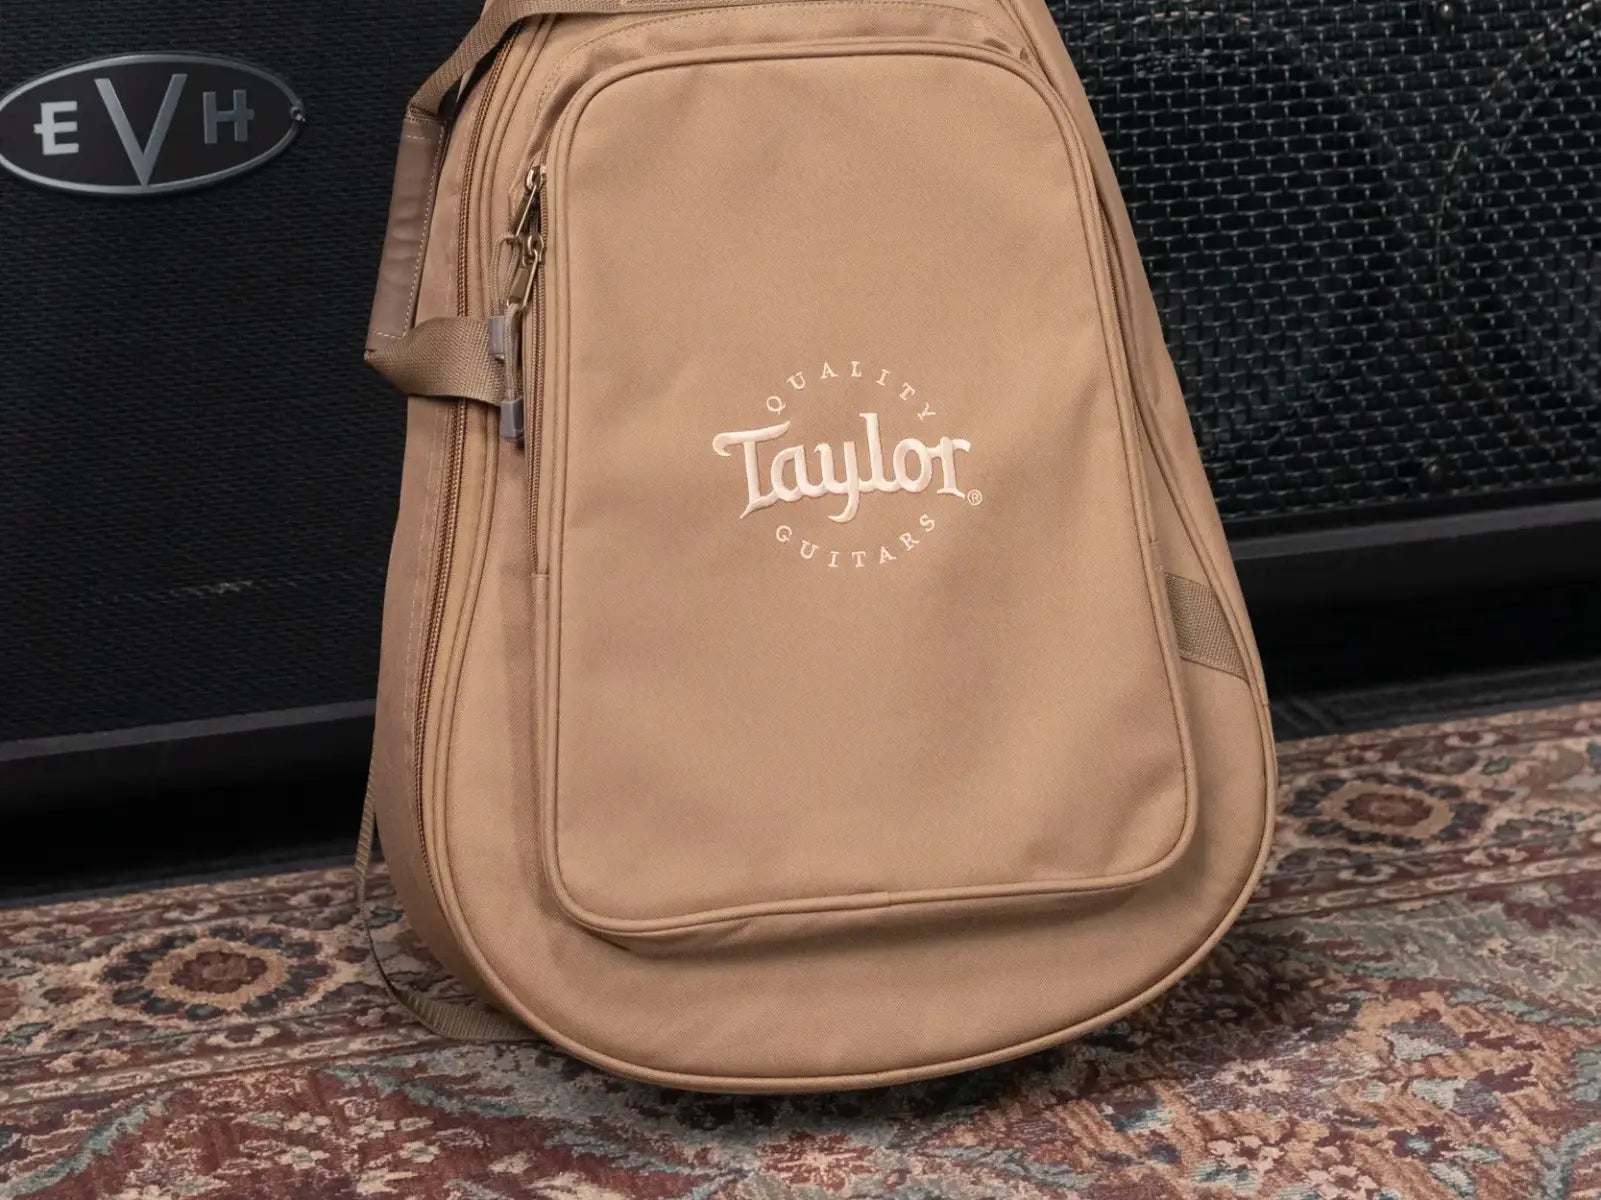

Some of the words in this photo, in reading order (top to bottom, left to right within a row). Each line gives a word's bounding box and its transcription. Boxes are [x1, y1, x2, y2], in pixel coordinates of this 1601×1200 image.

[33, 73, 255, 188] EVH
[766, 360, 937, 422] QUALITY
[775, 513, 936, 568] GUITARS
